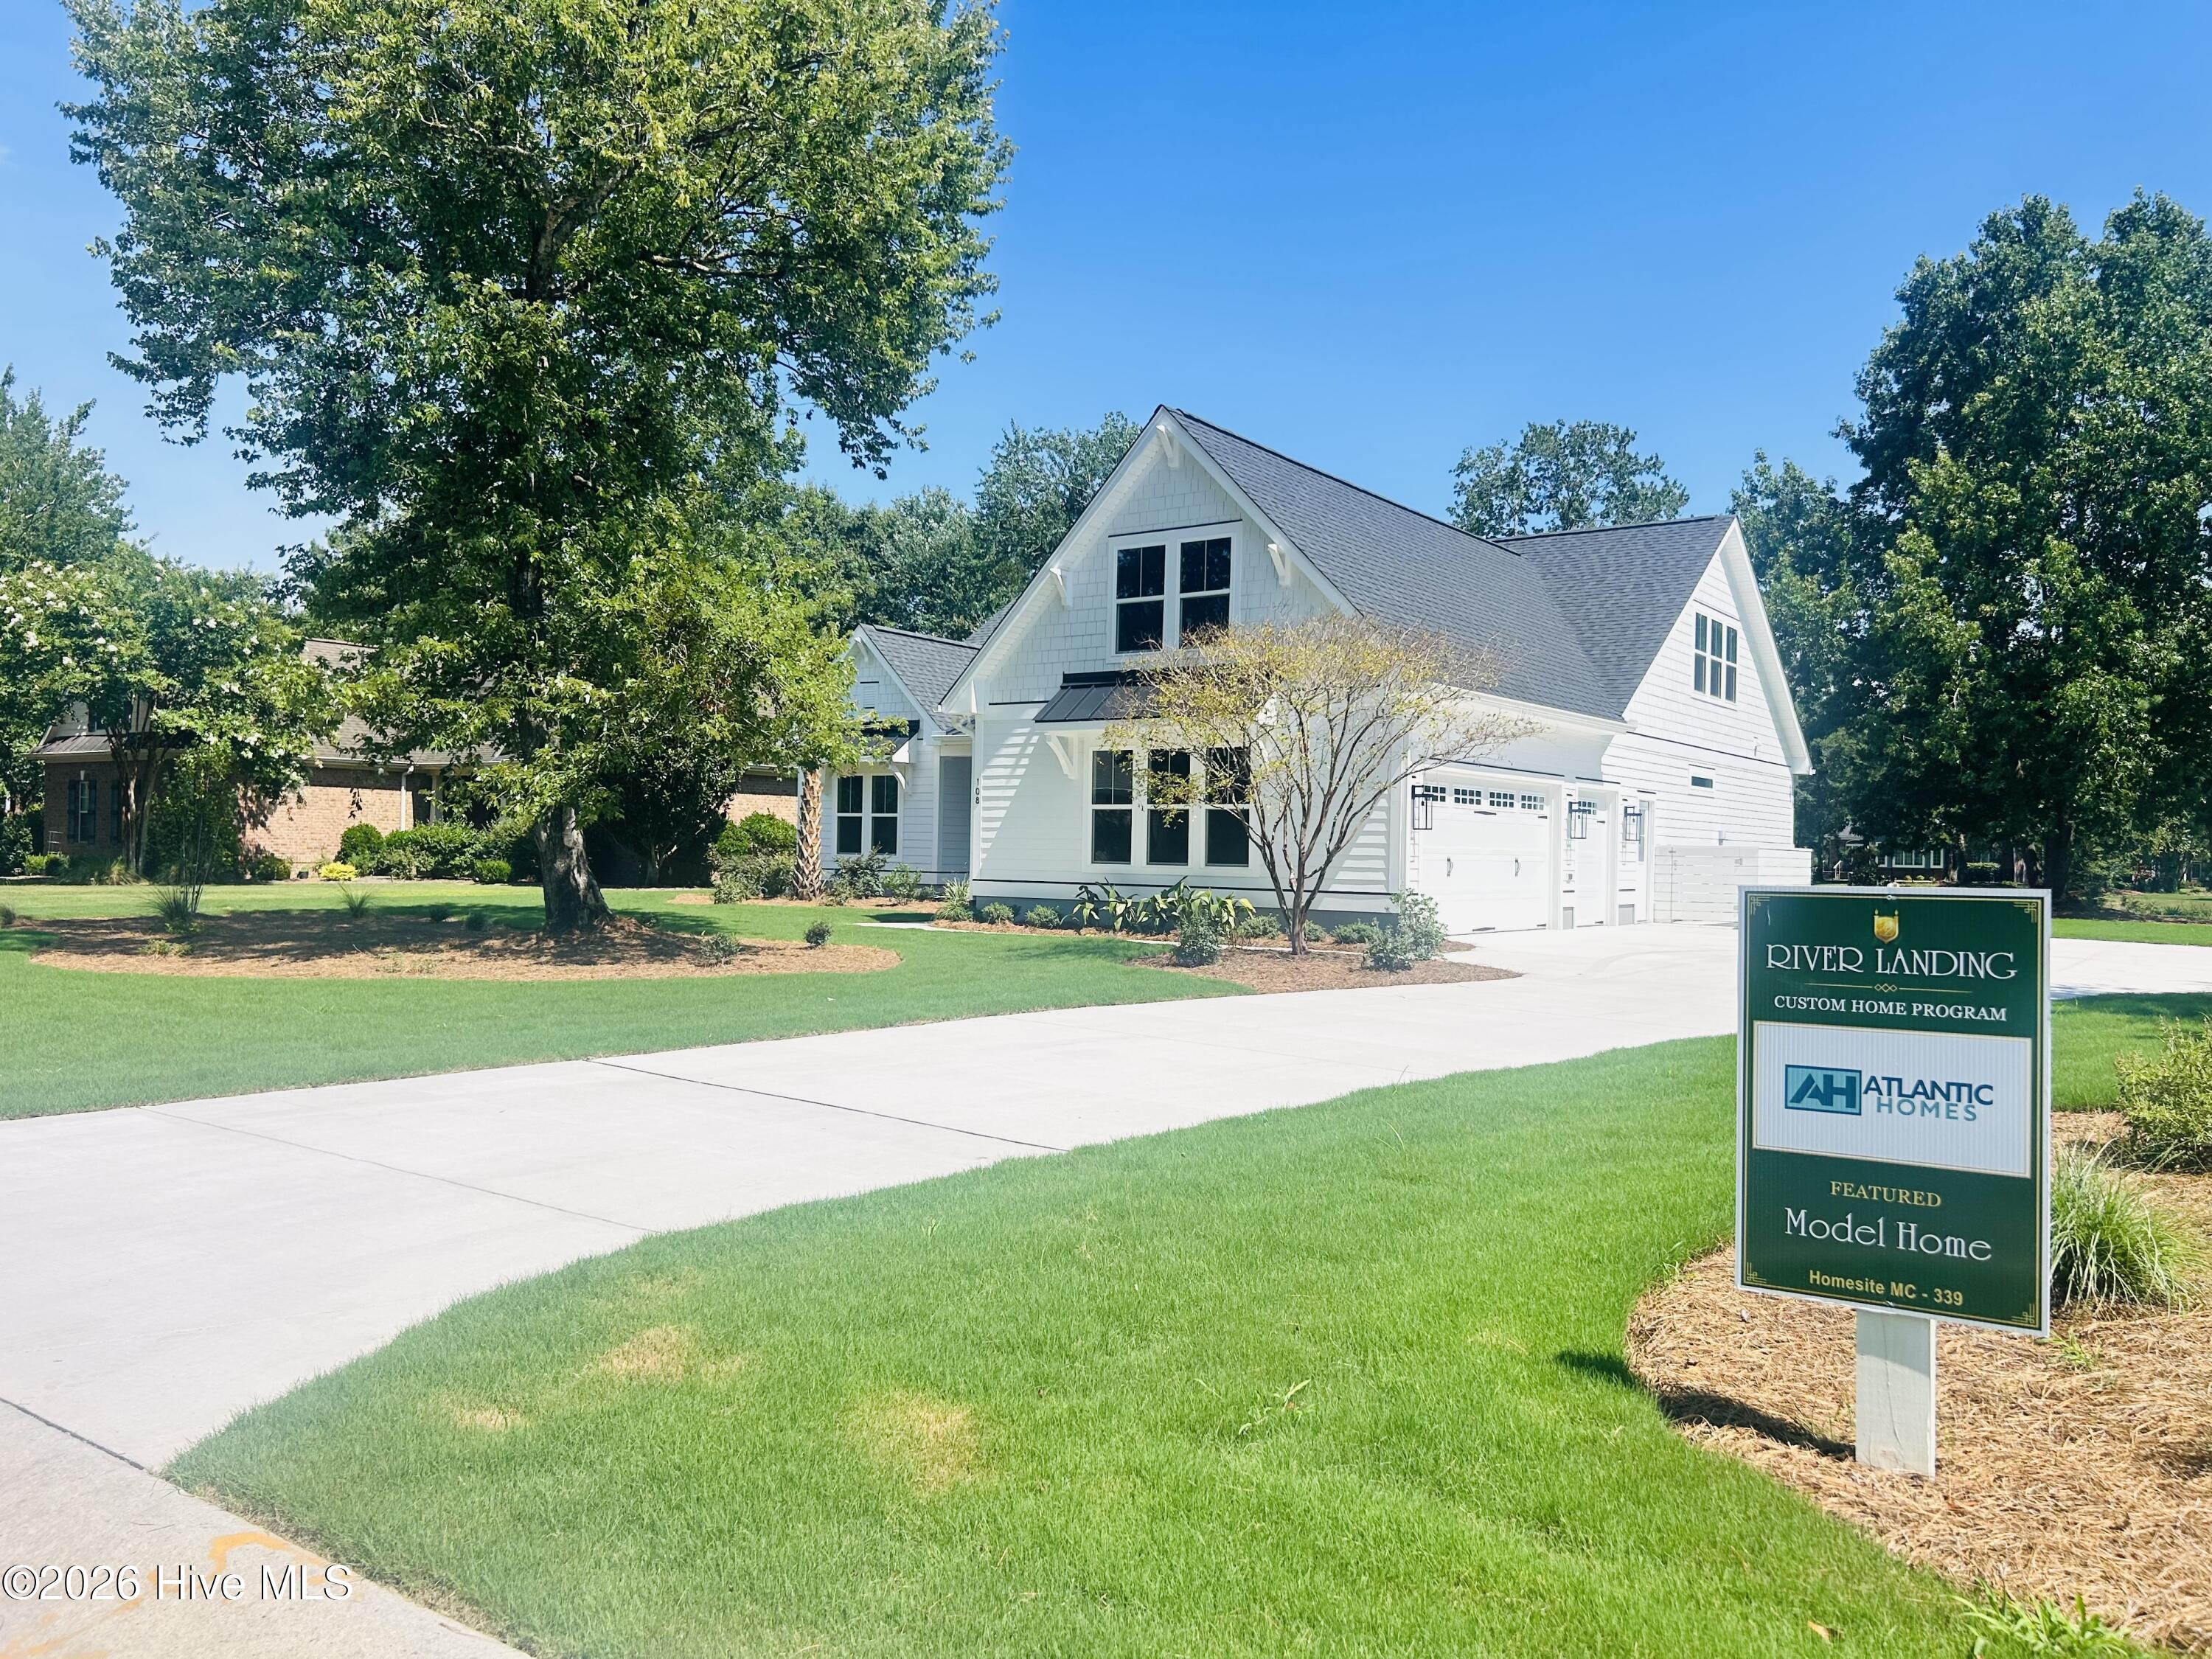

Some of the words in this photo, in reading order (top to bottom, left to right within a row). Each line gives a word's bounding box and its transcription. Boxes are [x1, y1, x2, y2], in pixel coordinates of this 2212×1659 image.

[1766, 944, 1864, 973] RIVER
[1875, 948, 2018, 980] LANDING
[1774, 995, 1846, 1012] CUSTOM
[1851, 1000, 1907, 1015] HOME
[1911, 1004, 2007, 1022] PROGRAM
[1790, 1074, 1857, 1109] AH
[1863, 1075, 1994, 1105] ATLANTIC
[1877, 1096, 1977, 1121] HOMES
[1830, 1180, 1941, 1208] FEATURED
[1784, 1207, 1885, 1247] Model
[1896, 1221, 1992, 1261] Home
[1809, 1270, 1885, 1295] Homesite
[1890, 1281, 1916, 1299] MC
[1933, 1288, 1964, 1307] 339
